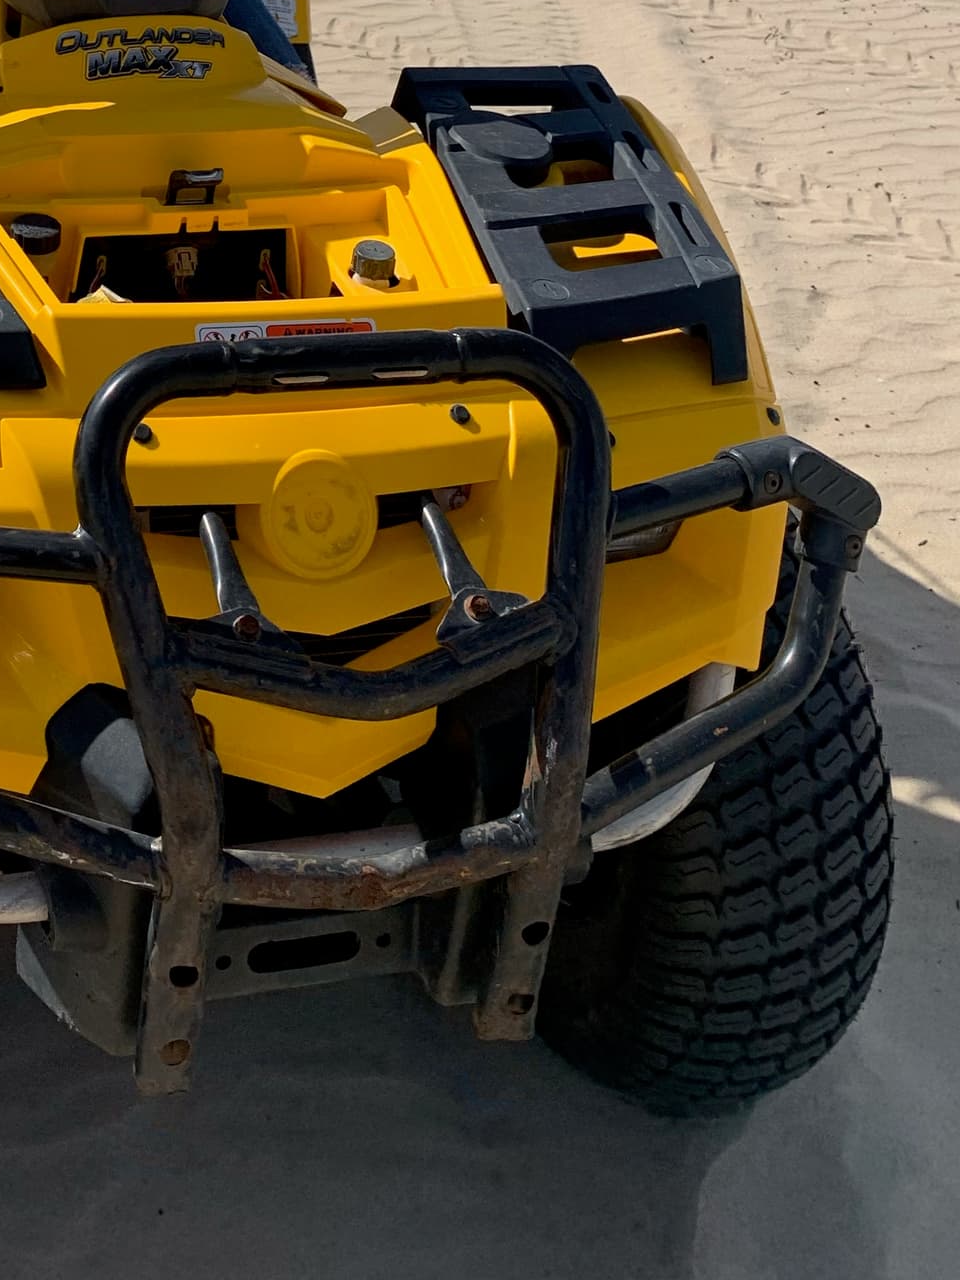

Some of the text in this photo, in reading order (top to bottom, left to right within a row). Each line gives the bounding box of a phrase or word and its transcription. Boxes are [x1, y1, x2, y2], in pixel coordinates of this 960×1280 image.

[56, 28, 225, 53] OUTLANDER
[86, 46, 211, 80] MAX XT
